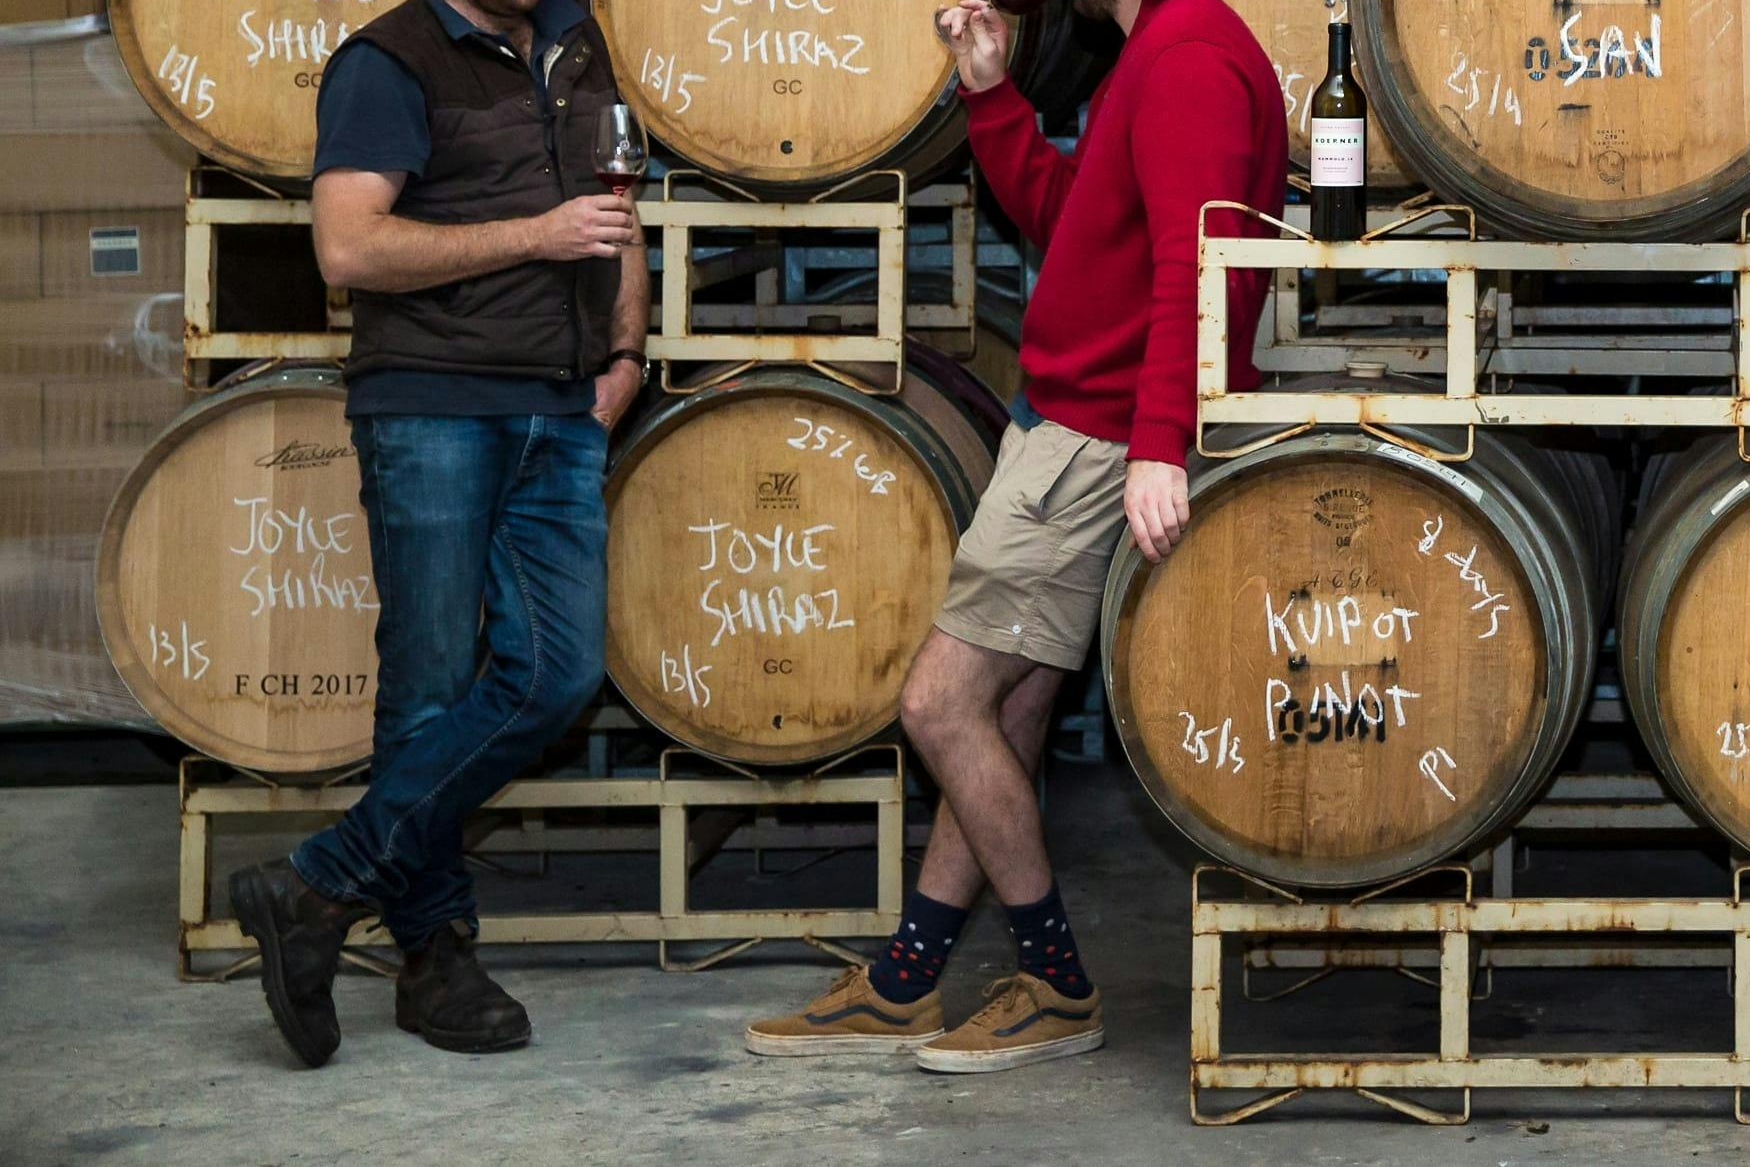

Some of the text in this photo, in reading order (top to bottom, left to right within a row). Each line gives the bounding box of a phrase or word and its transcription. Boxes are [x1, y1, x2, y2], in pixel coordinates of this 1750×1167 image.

[238, 9, 363, 68] SHIR
[706, 16, 872, 75] SHIRAZ
[1559, 10, 1663, 87] SAN
[640, 47, 707, 115] 13/5
[772, 78, 804, 96] GC
[1314, 137, 1359, 145] KOERNER
[229, 496, 356, 555] JOYCE
[688, 518, 836, 574] JOYCE
[239, 552, 382, 618] SHIRAZ
[699, 578, 855, 648] SHIRAZ
[235, 674, 369, 696] F CH 2017
[660, 644, 713, 708] 13/5
[762, 659, 793, 675] GC
[1265, 670, 1423, 742] PINOT
